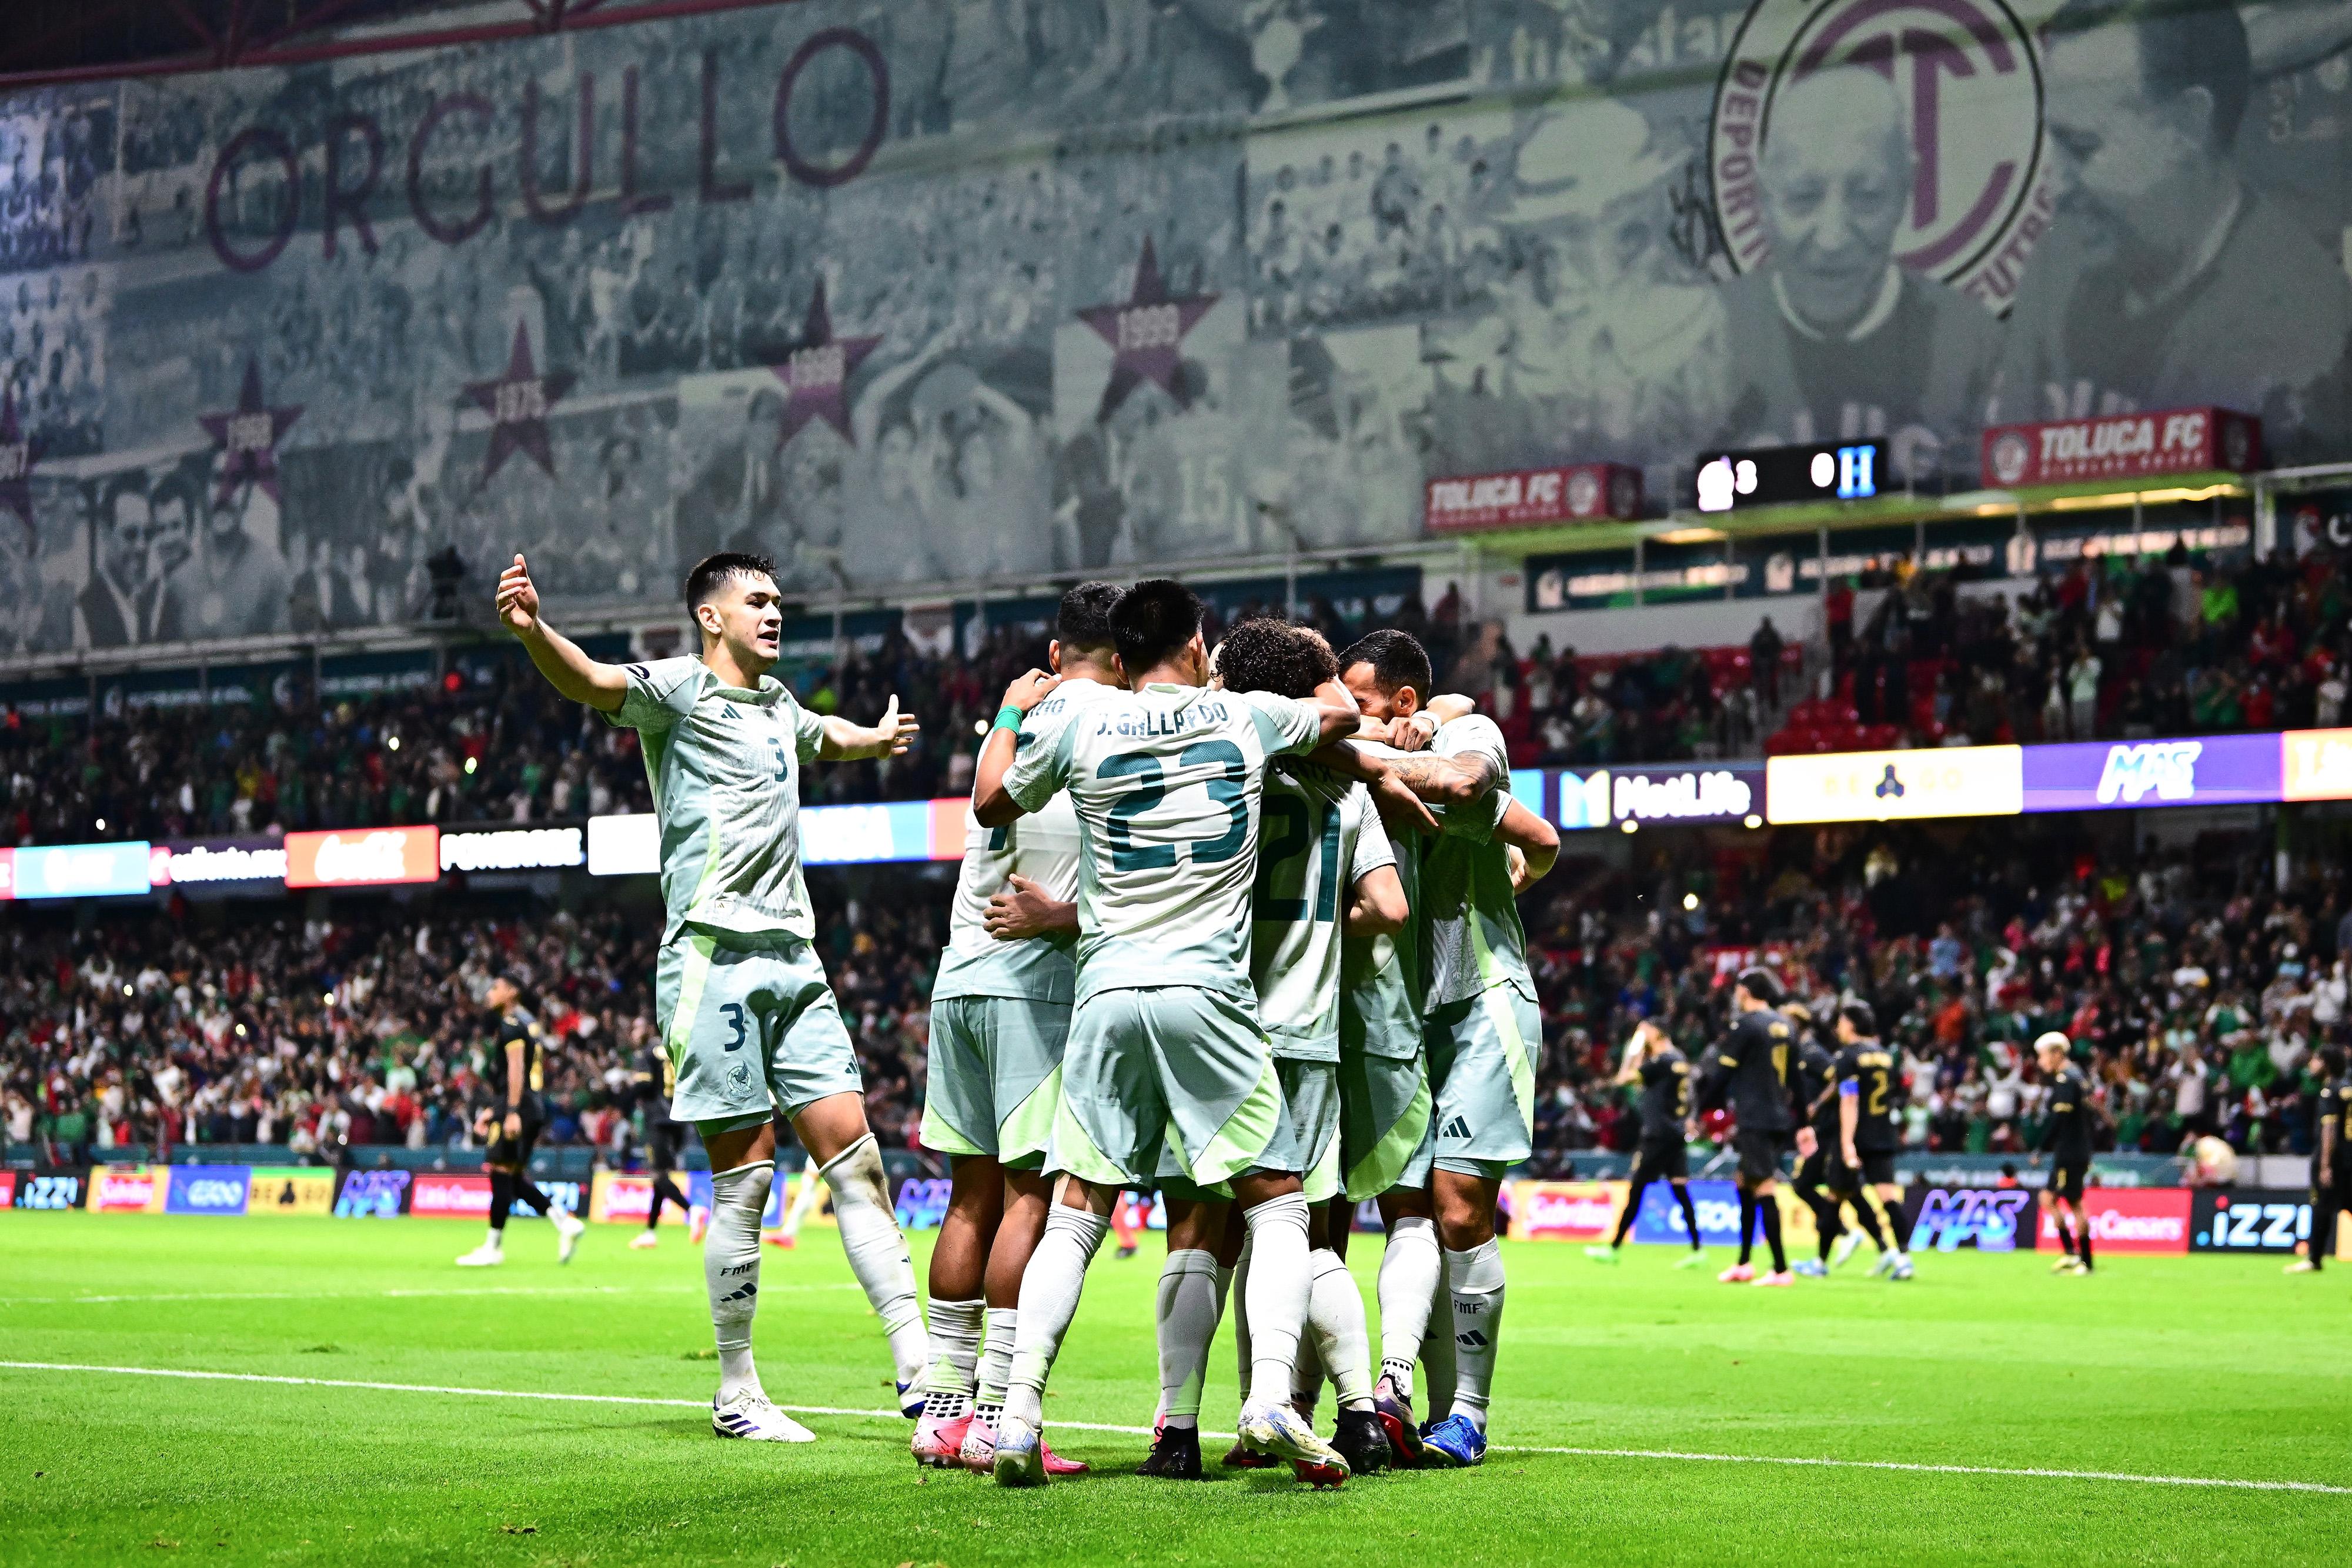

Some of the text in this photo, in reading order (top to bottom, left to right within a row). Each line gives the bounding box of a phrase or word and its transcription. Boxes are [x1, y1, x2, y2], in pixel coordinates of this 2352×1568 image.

[205, 26, 890, 272] ORGULLO
[1963, 179, 2052, 297] FUTB
[2040, 412, 2206, 461] TOLUCA FC
[768, 737, 788, 783] 3
[1097, 740, 1249, 872] 23
[1253, 794, 1341, 922] 21
[719, 1002, 746, 1052] 3
[720, 1262, 756, 1277] FMF
[1454, 1298, 1484, 1315] FMF
